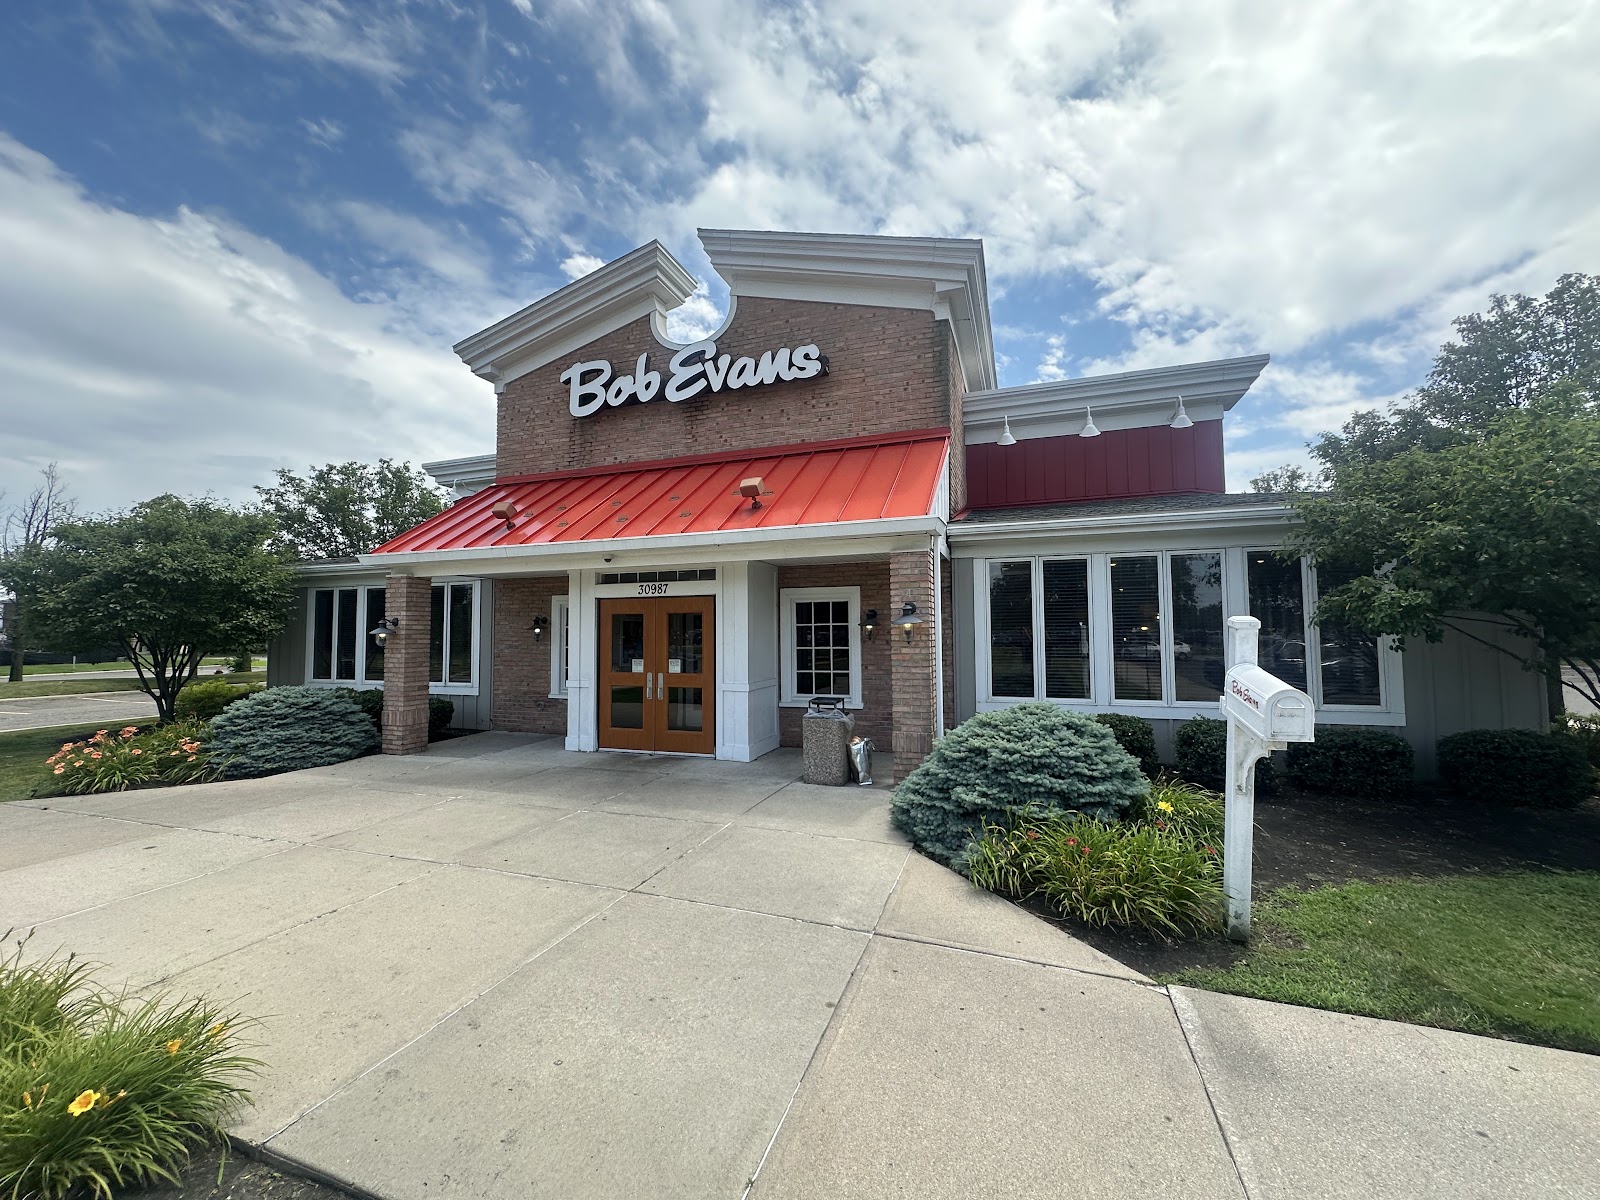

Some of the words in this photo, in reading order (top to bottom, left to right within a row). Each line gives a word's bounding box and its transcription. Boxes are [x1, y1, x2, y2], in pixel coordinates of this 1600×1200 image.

[560, 352, 661, 417] Bob
[664, 340, 821, 402] Evans
[637, 583, 669, 595] 30987
